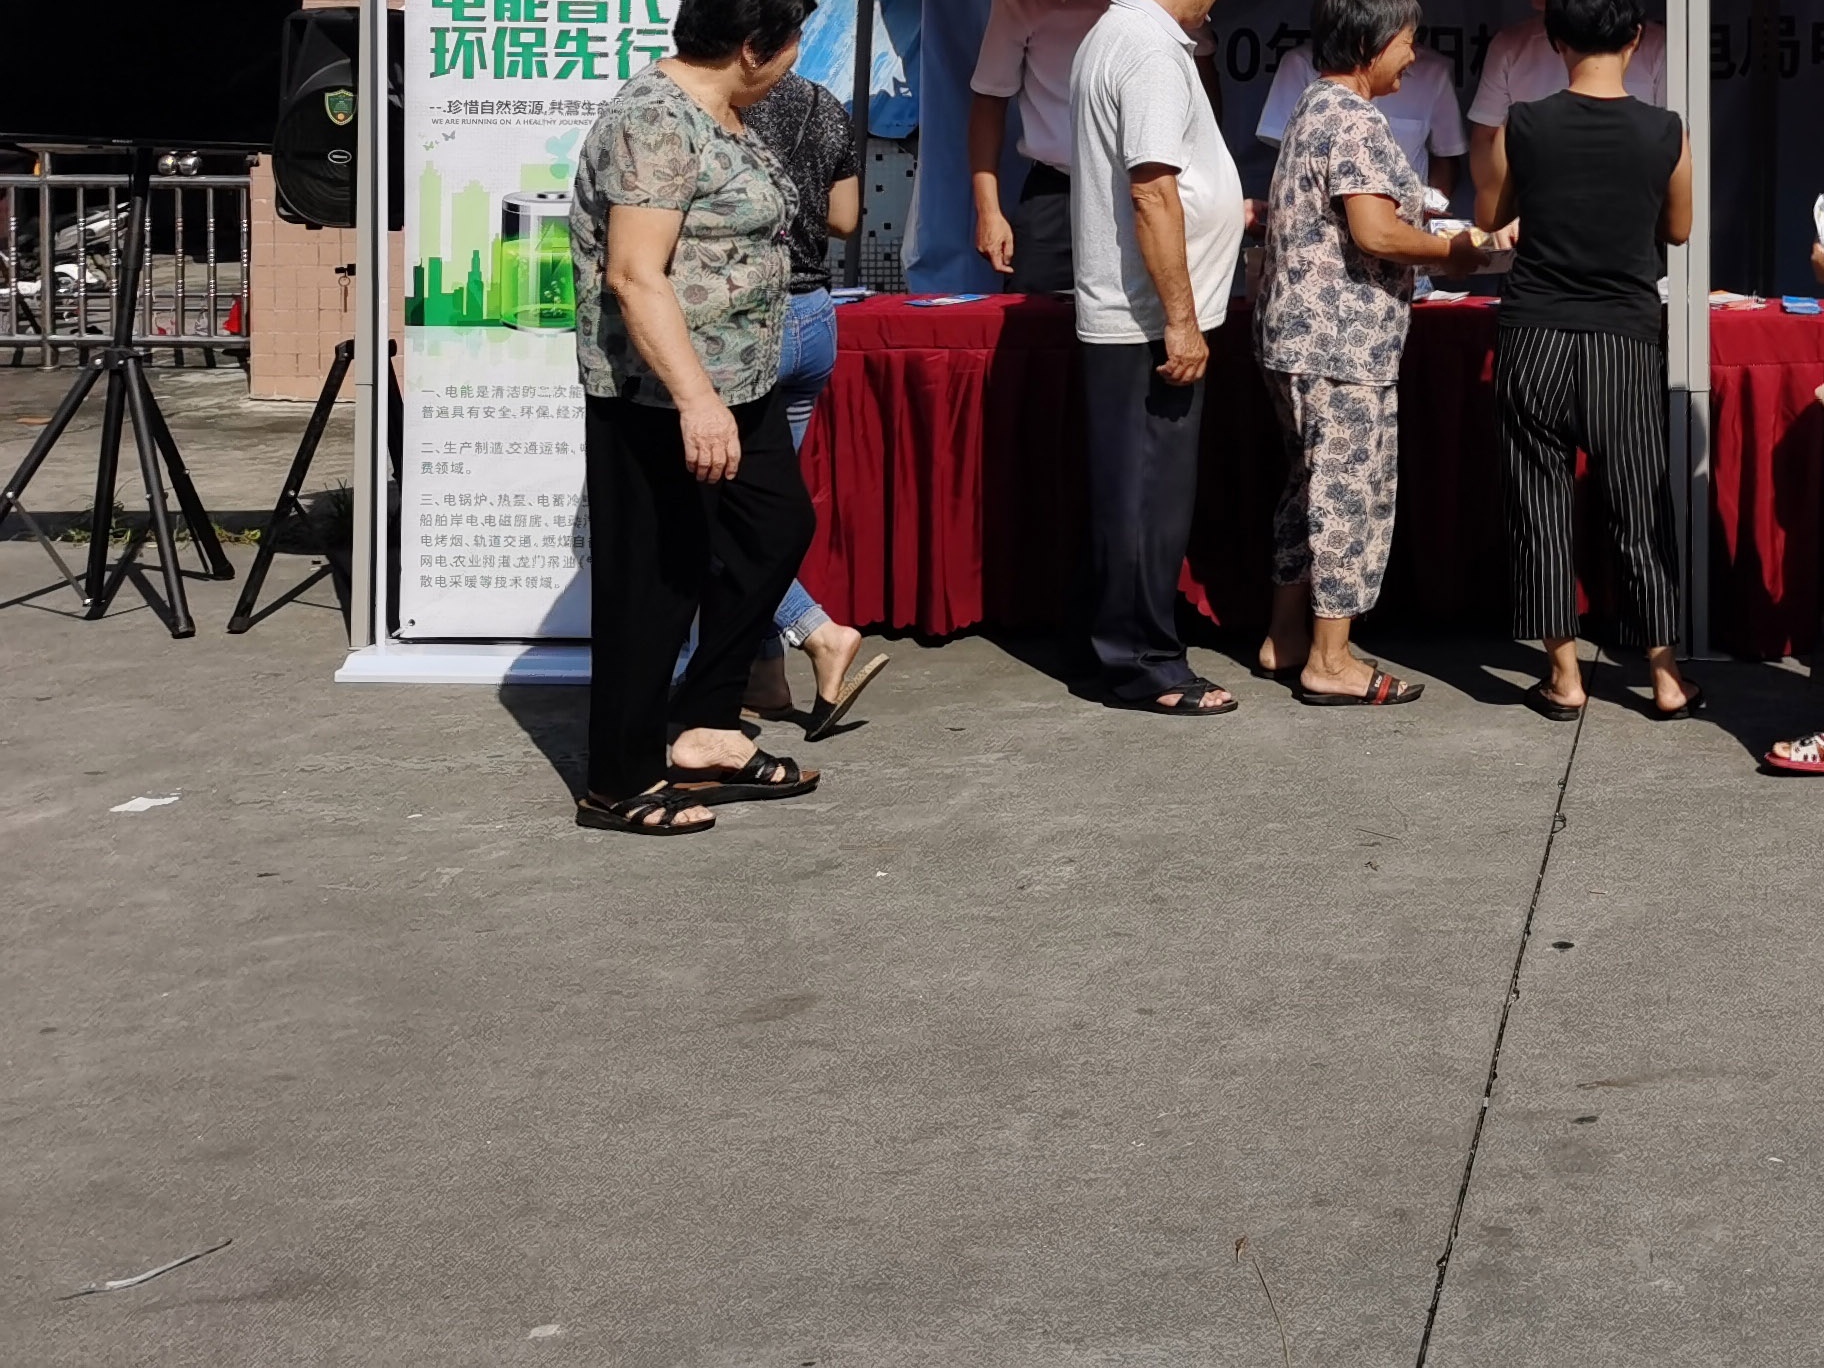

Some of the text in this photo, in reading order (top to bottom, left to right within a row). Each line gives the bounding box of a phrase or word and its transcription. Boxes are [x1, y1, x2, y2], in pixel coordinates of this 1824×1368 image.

[429, 25, 670, 80] 环保先行
[431, 118, 444, 126] WE
[445, 118, 460, 126] ARE
[461, 118, 498, 126] RUNNING
[499, 118, 512, 126] ON
[515, 118, 522, 126] A
[523, 118, 557, 126] HEALTHY
[420, 461, 472, 475] 费领域。
[420, 533, 592, 549] 电烤烟、轨道交通、燃煤自
